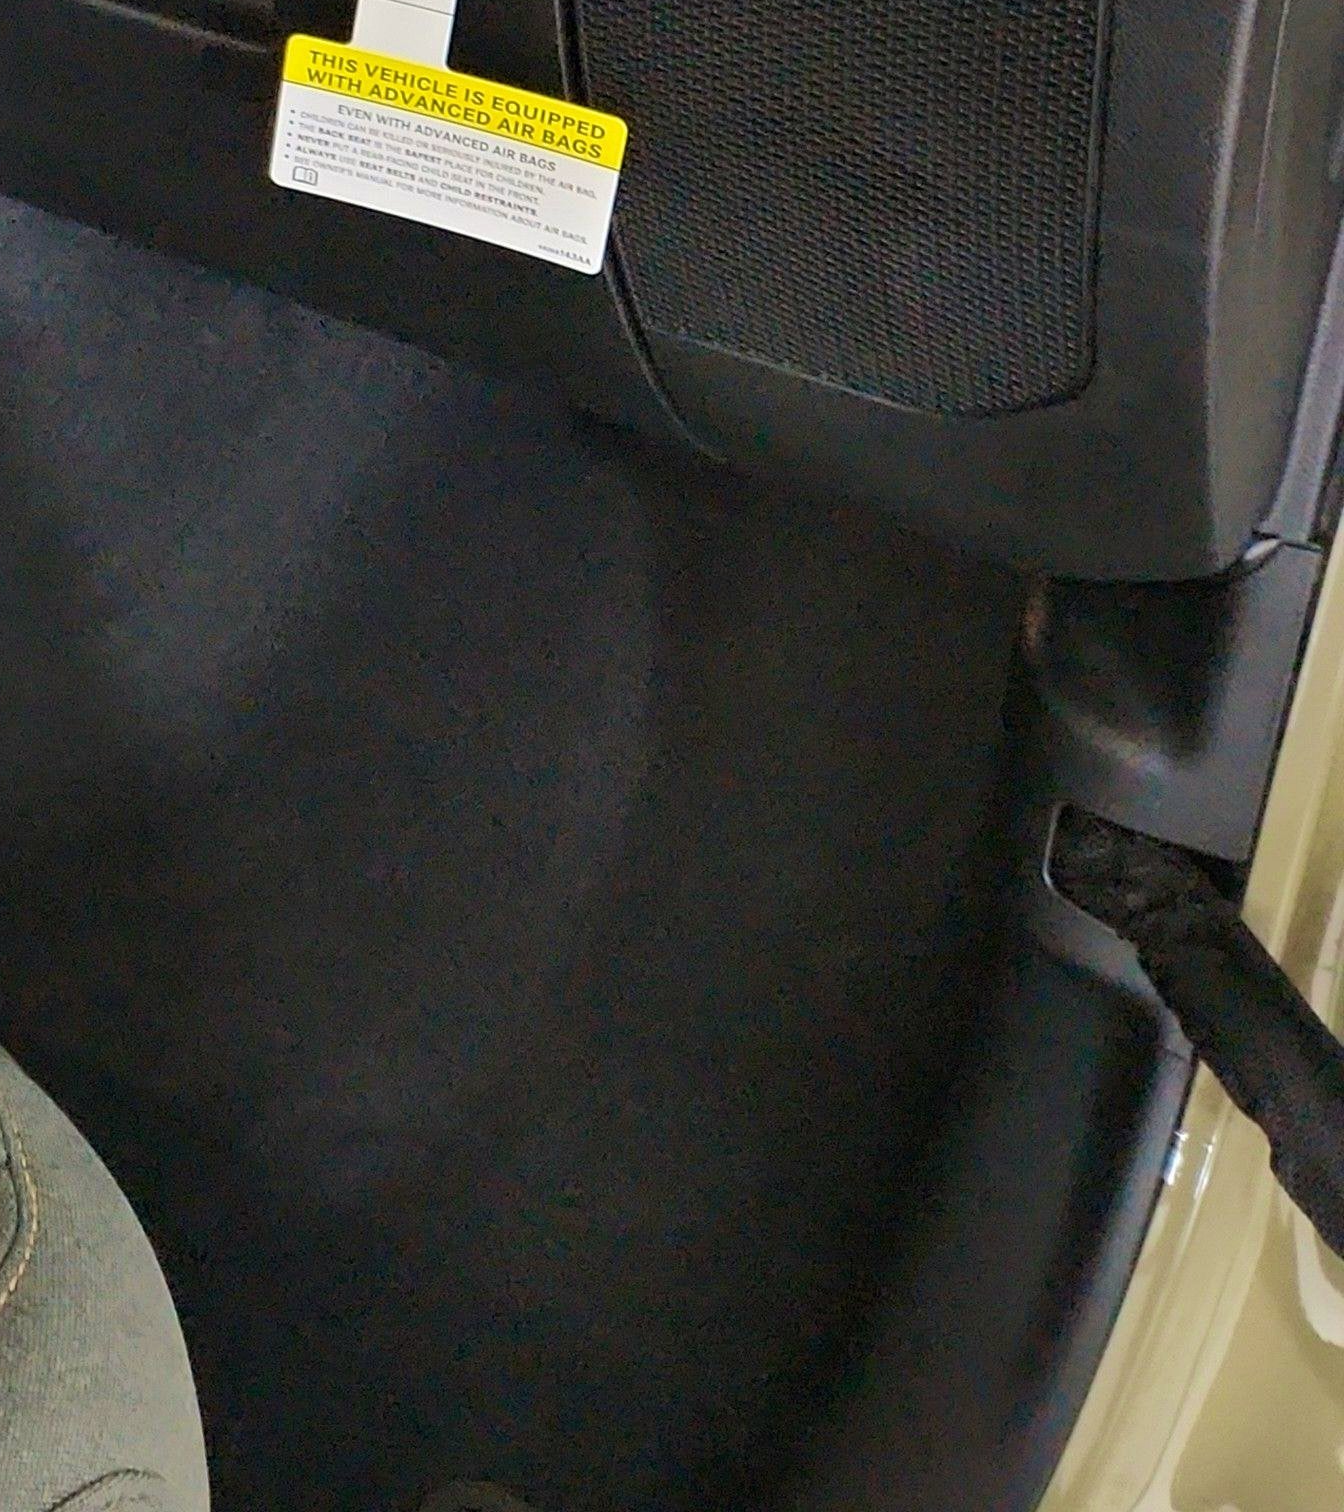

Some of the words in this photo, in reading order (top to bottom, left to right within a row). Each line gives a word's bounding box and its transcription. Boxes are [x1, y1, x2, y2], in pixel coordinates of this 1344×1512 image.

[306, 68, 361, 92] WITH
[370, 83, 490, 125] ADVANCED
[498, 117, 534, 138] AIR
[543, 130, 601, 158] BAGS
[309, 50, 357, 73] THIS
[364, 63, 457, 98] VEHICLE
[465, 89, 484, 105] IS
[492, 96, 605, 139] EQUIPPED
[297, 144, 336, 160] ALWAYS
[441, 182, 472, 196] CHILD
[338, 104, 372, 121] EVEN
[376, 113, 411, 130] WITH
[415, 124, 489, 152] ADVANCED
[493, 144, 516, 159] AIR
[520, 153, 556, 171] BAGS
[405, 149, 441, 164] SAFEST
